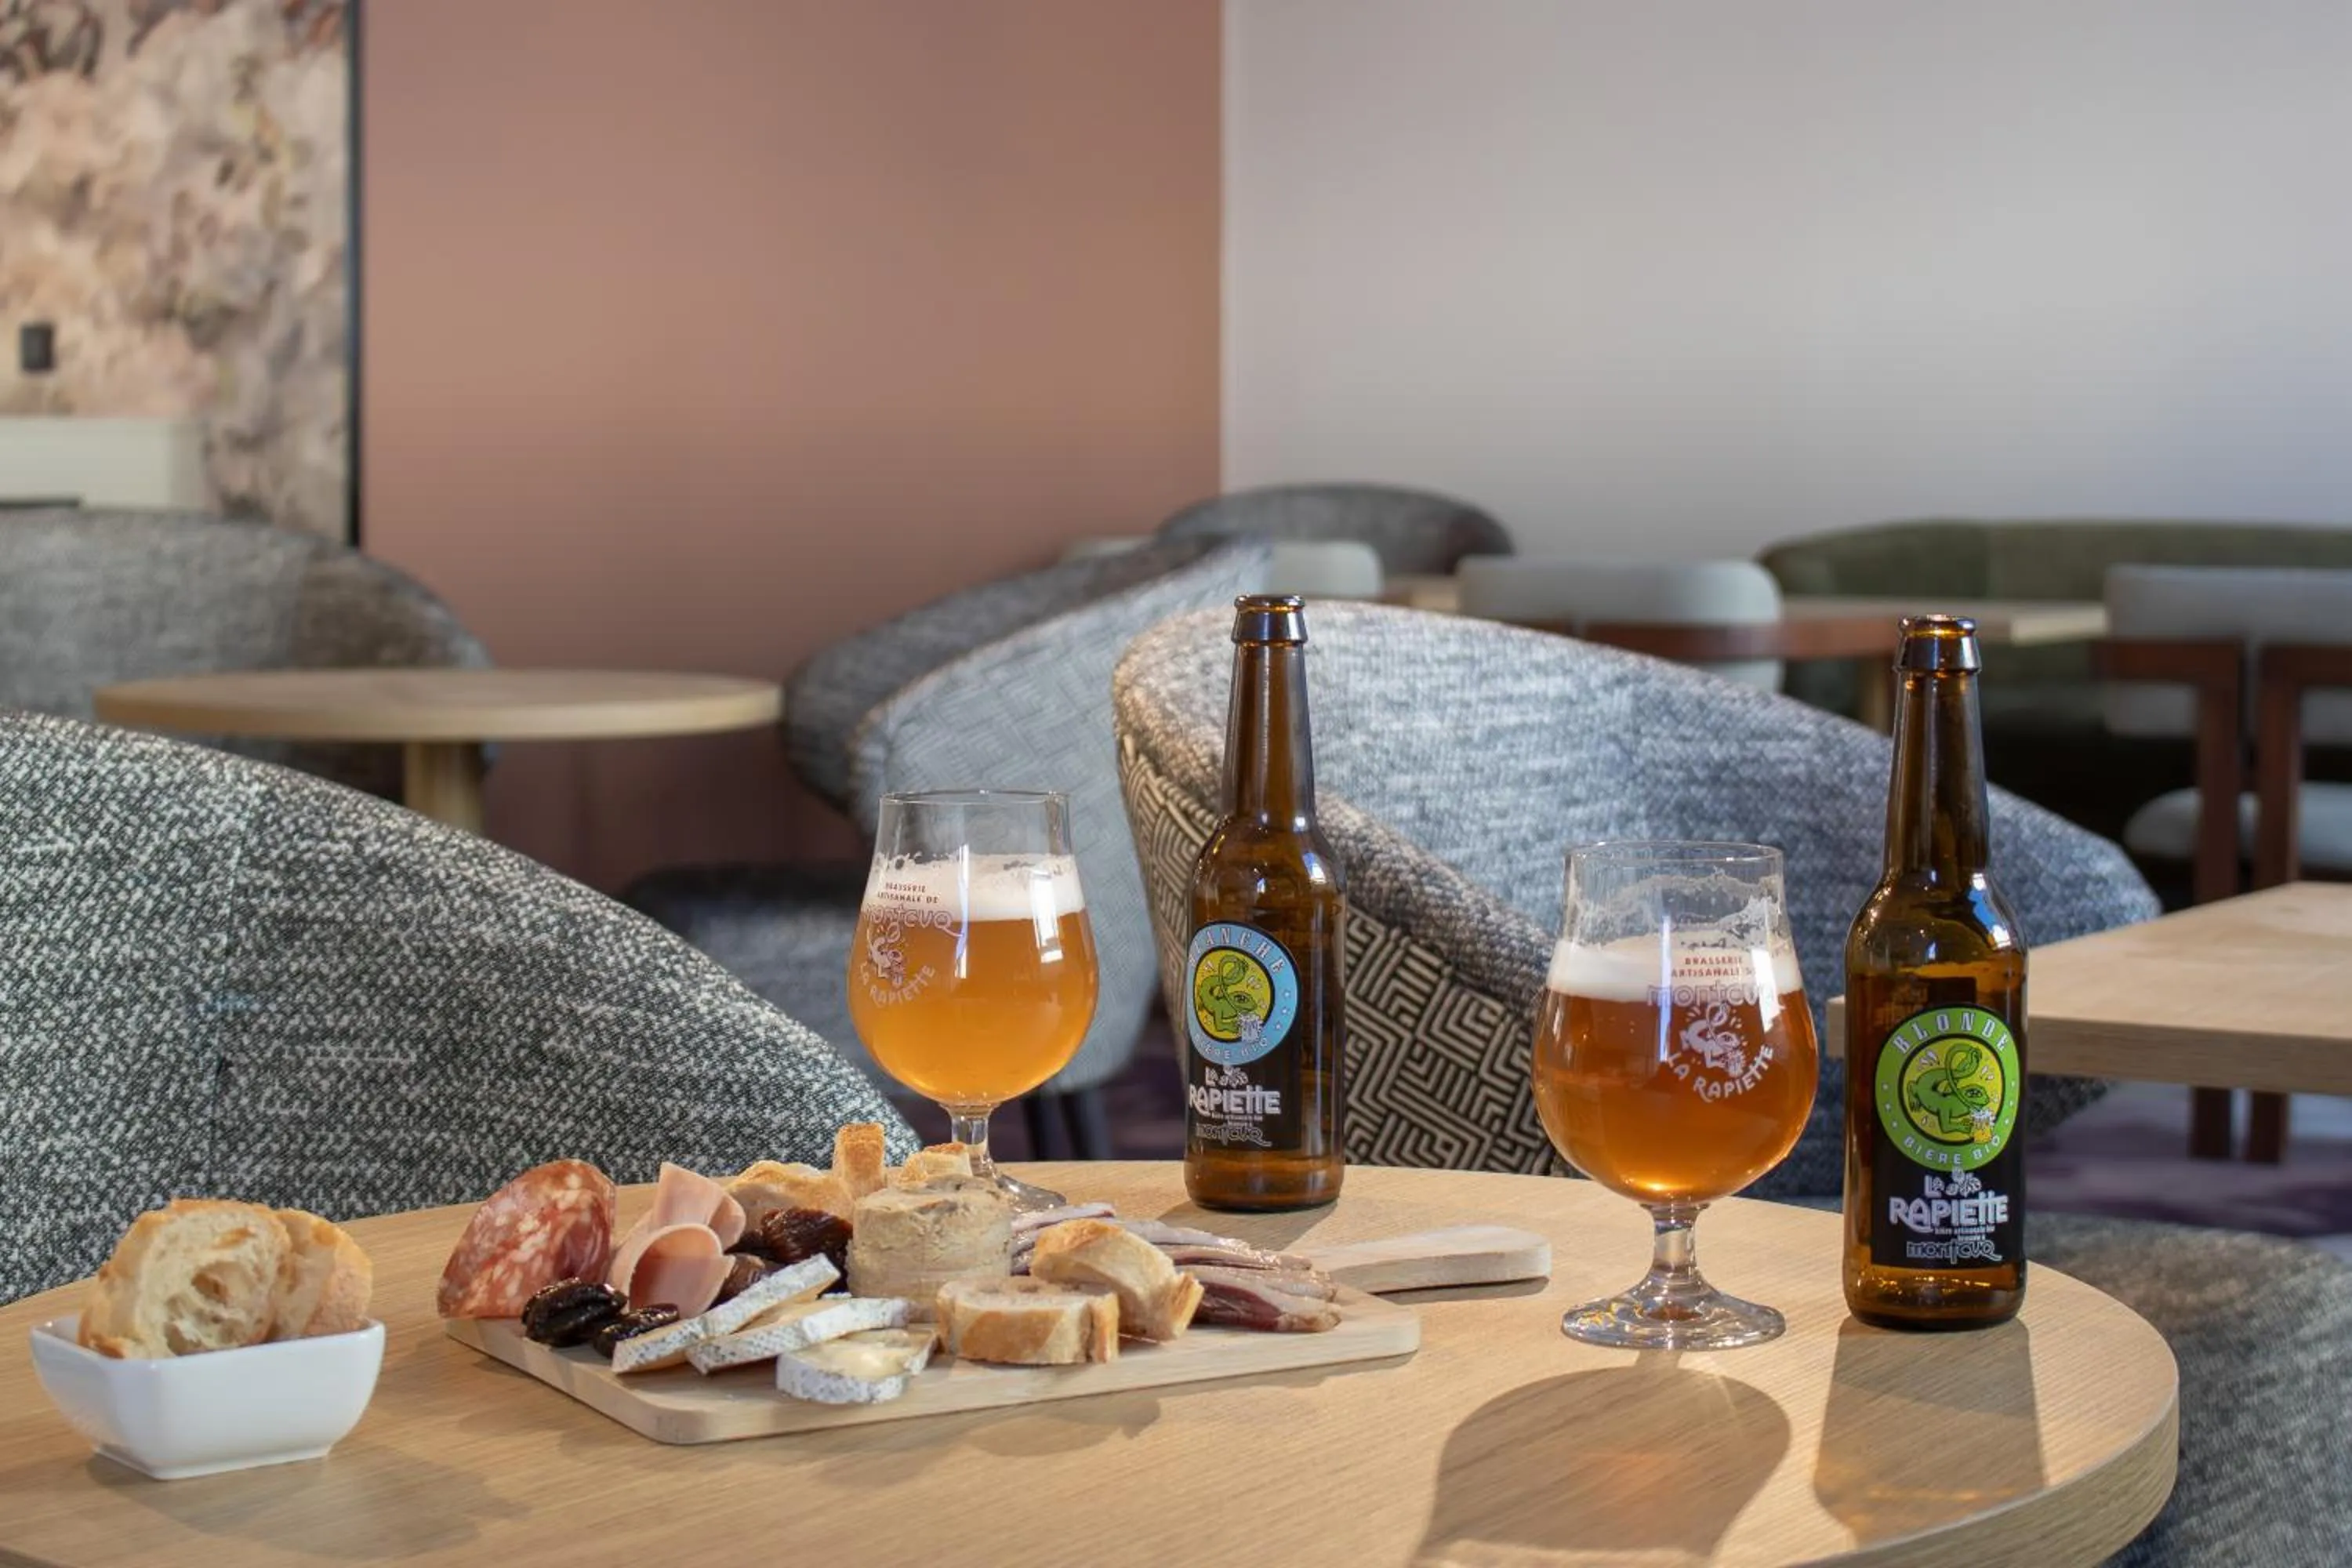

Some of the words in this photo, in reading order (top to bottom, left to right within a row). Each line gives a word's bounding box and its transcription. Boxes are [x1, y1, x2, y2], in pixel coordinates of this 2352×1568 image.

[1685, 956, 1743, 965] BRASSERIE
[1893, 1011, 2009, 1054] BLONDE
[1693, 1044, 1773, 1103] RAPIETTE
[1973, 1134, 2000, 1160] BIO
